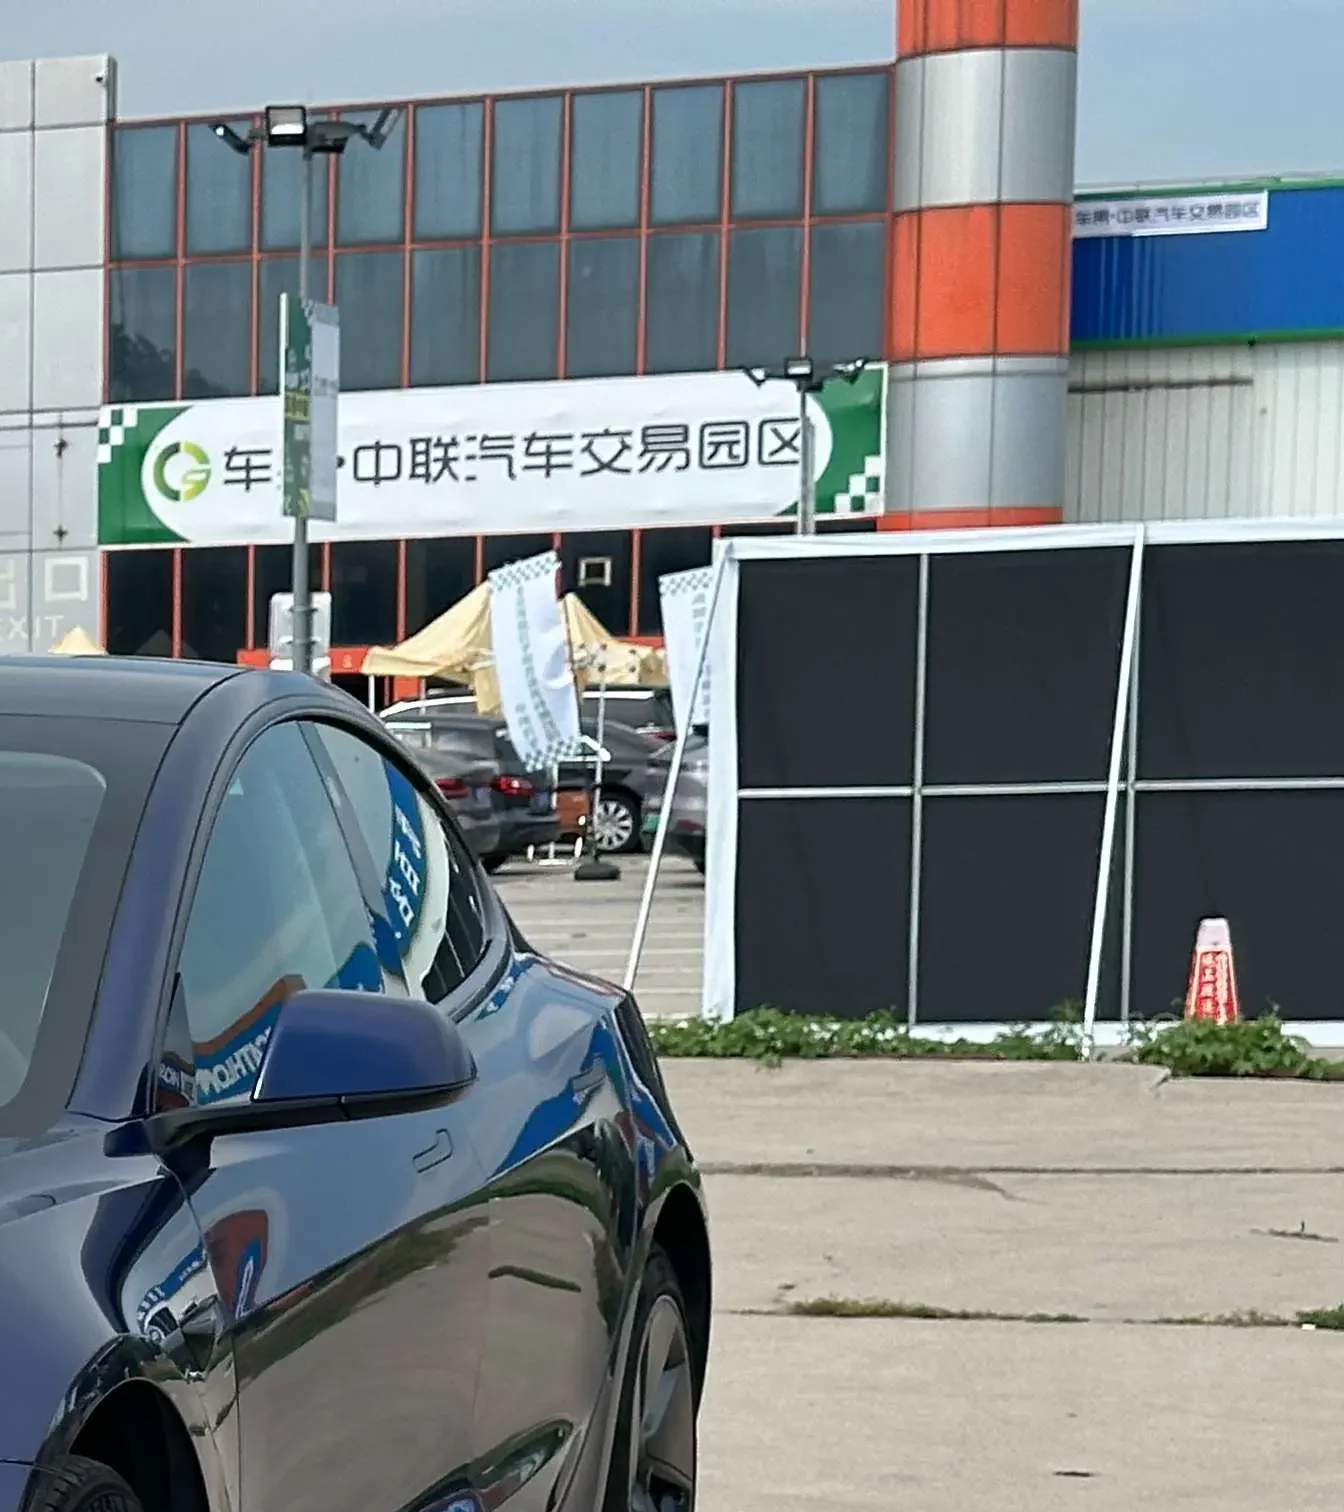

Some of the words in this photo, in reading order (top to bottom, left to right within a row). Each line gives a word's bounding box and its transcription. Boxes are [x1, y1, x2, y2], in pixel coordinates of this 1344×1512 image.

[223, 417, 802, 492] 车·中联汽车交易园区
